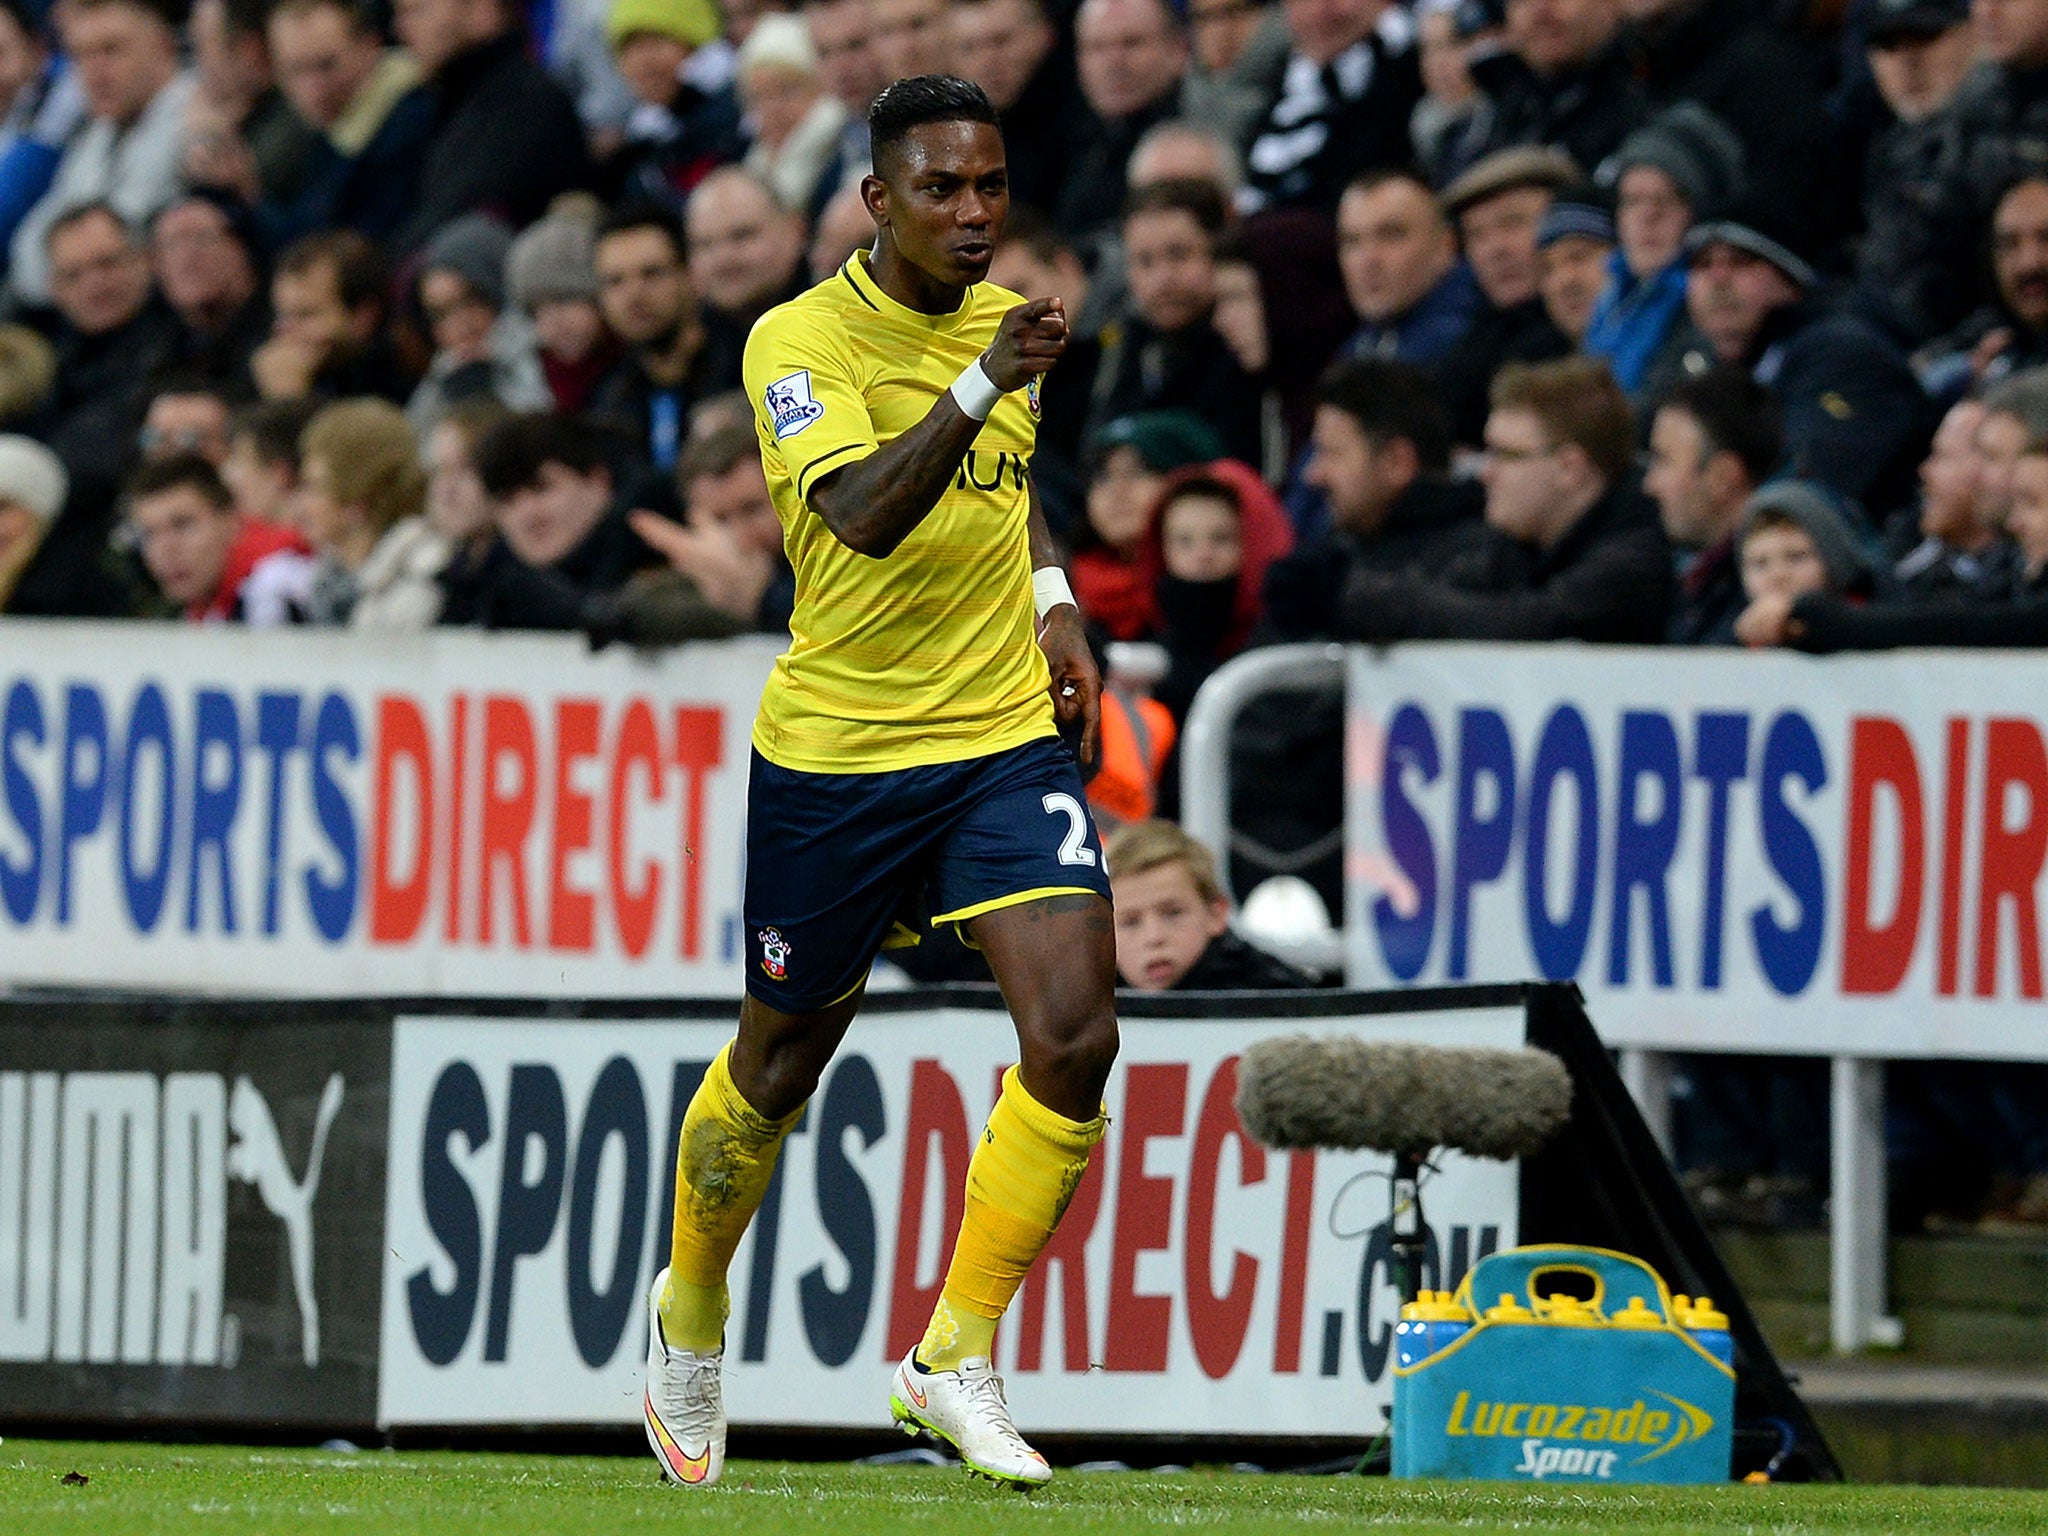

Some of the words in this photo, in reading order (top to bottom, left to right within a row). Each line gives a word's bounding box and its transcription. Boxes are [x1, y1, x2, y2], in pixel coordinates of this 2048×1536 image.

[1042, 792, 1108, 876] 2
[1373, 699, 2048, 1000] SPORTSDIR
[1447, 1390, 1671, 1444] Lucozade
[1515, 1439, 1618, 1479] Sport
